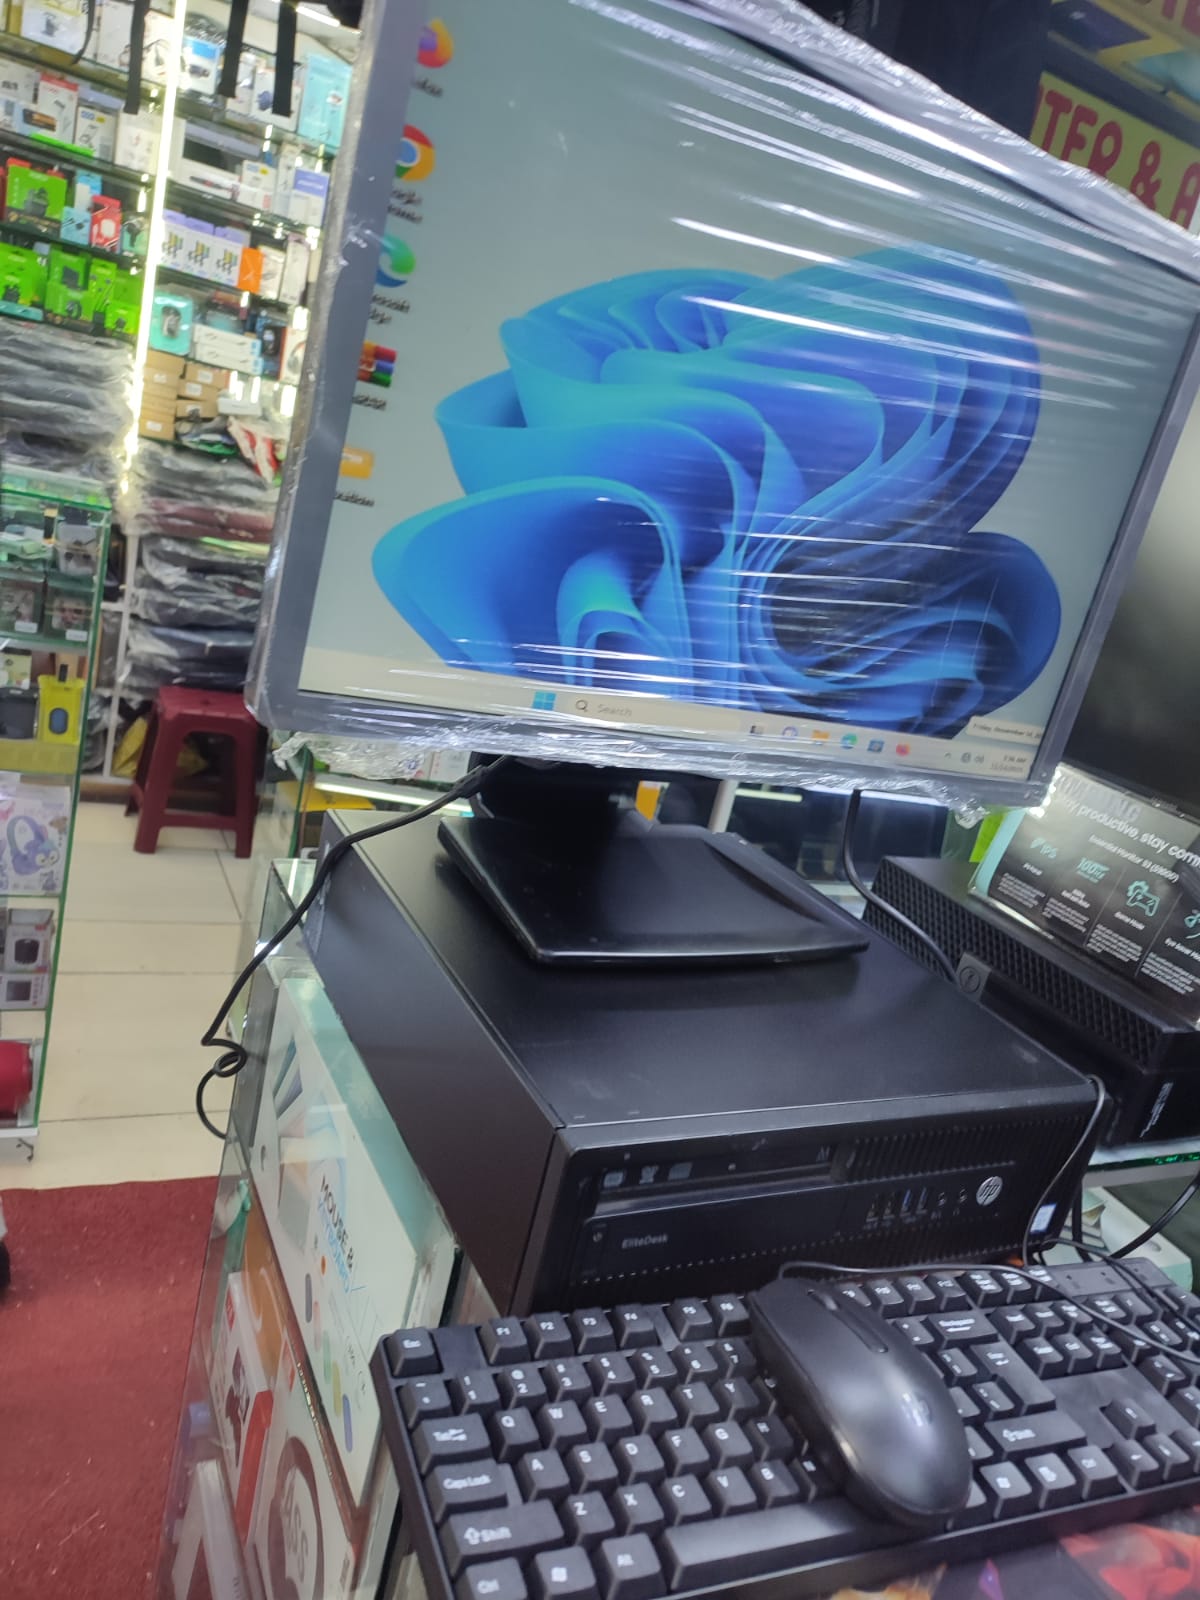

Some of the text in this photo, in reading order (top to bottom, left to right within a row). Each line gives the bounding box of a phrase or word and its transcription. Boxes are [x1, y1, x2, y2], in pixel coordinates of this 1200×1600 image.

[597, 703, 633, 717] Search
[1077, 804, 1139, 840] productive,
[1139, 831, 1170, 854] stay
[1168, 845, 1200, 869] com
[978, 1177, 1001, 1205] hp
[320, 1174, 351, 1254] MOUSE
[620, 1233, 669, 1249] EliteDesk
[682, 1306, 697, 1315] F5
[720, 1302, 735, 1311] F6
[582, 1317, 597, 1326] F3
[624, 1312, 638, 1321] F4
[496, 1327, 511, 1336] F1
[540, 1321, 555, 1331] F2
[691, 1359, 701, 1369] 6
[730, 1354, 739, 1363] 7
[607, 1370, 616, 1380] 4
[649, 1364, 660, 1374] 5
[561, 1377, 572, 1387] 3
[724, 1383, 736, 1393] Y
[517, 1383, 528, 1394] 2
[683, 1388, 694, 1400] T
[640, 1394, 654, 1406] R
[548, 1407, 564, 1419] W
[594, 1401, 607, 1413] E
[501, 1415, 515, 1428] Q
[715, 1428, 730, 1440] G
[671, 1435, 682, 1447] F
[625, 1442, 639, 1456] D
[578, 1450, 592, 1463] S
[531, 1457, 545, 1471] A
[761, 1467, 775, 1480] B
[717, 1475, 729, 1488] V
[672, 1484, 686, 1498] C
[624, 1493, 639, 1506] X
[573, 1502, 588, 1516] Z
[480, 1527, 512, 1542] Shift
